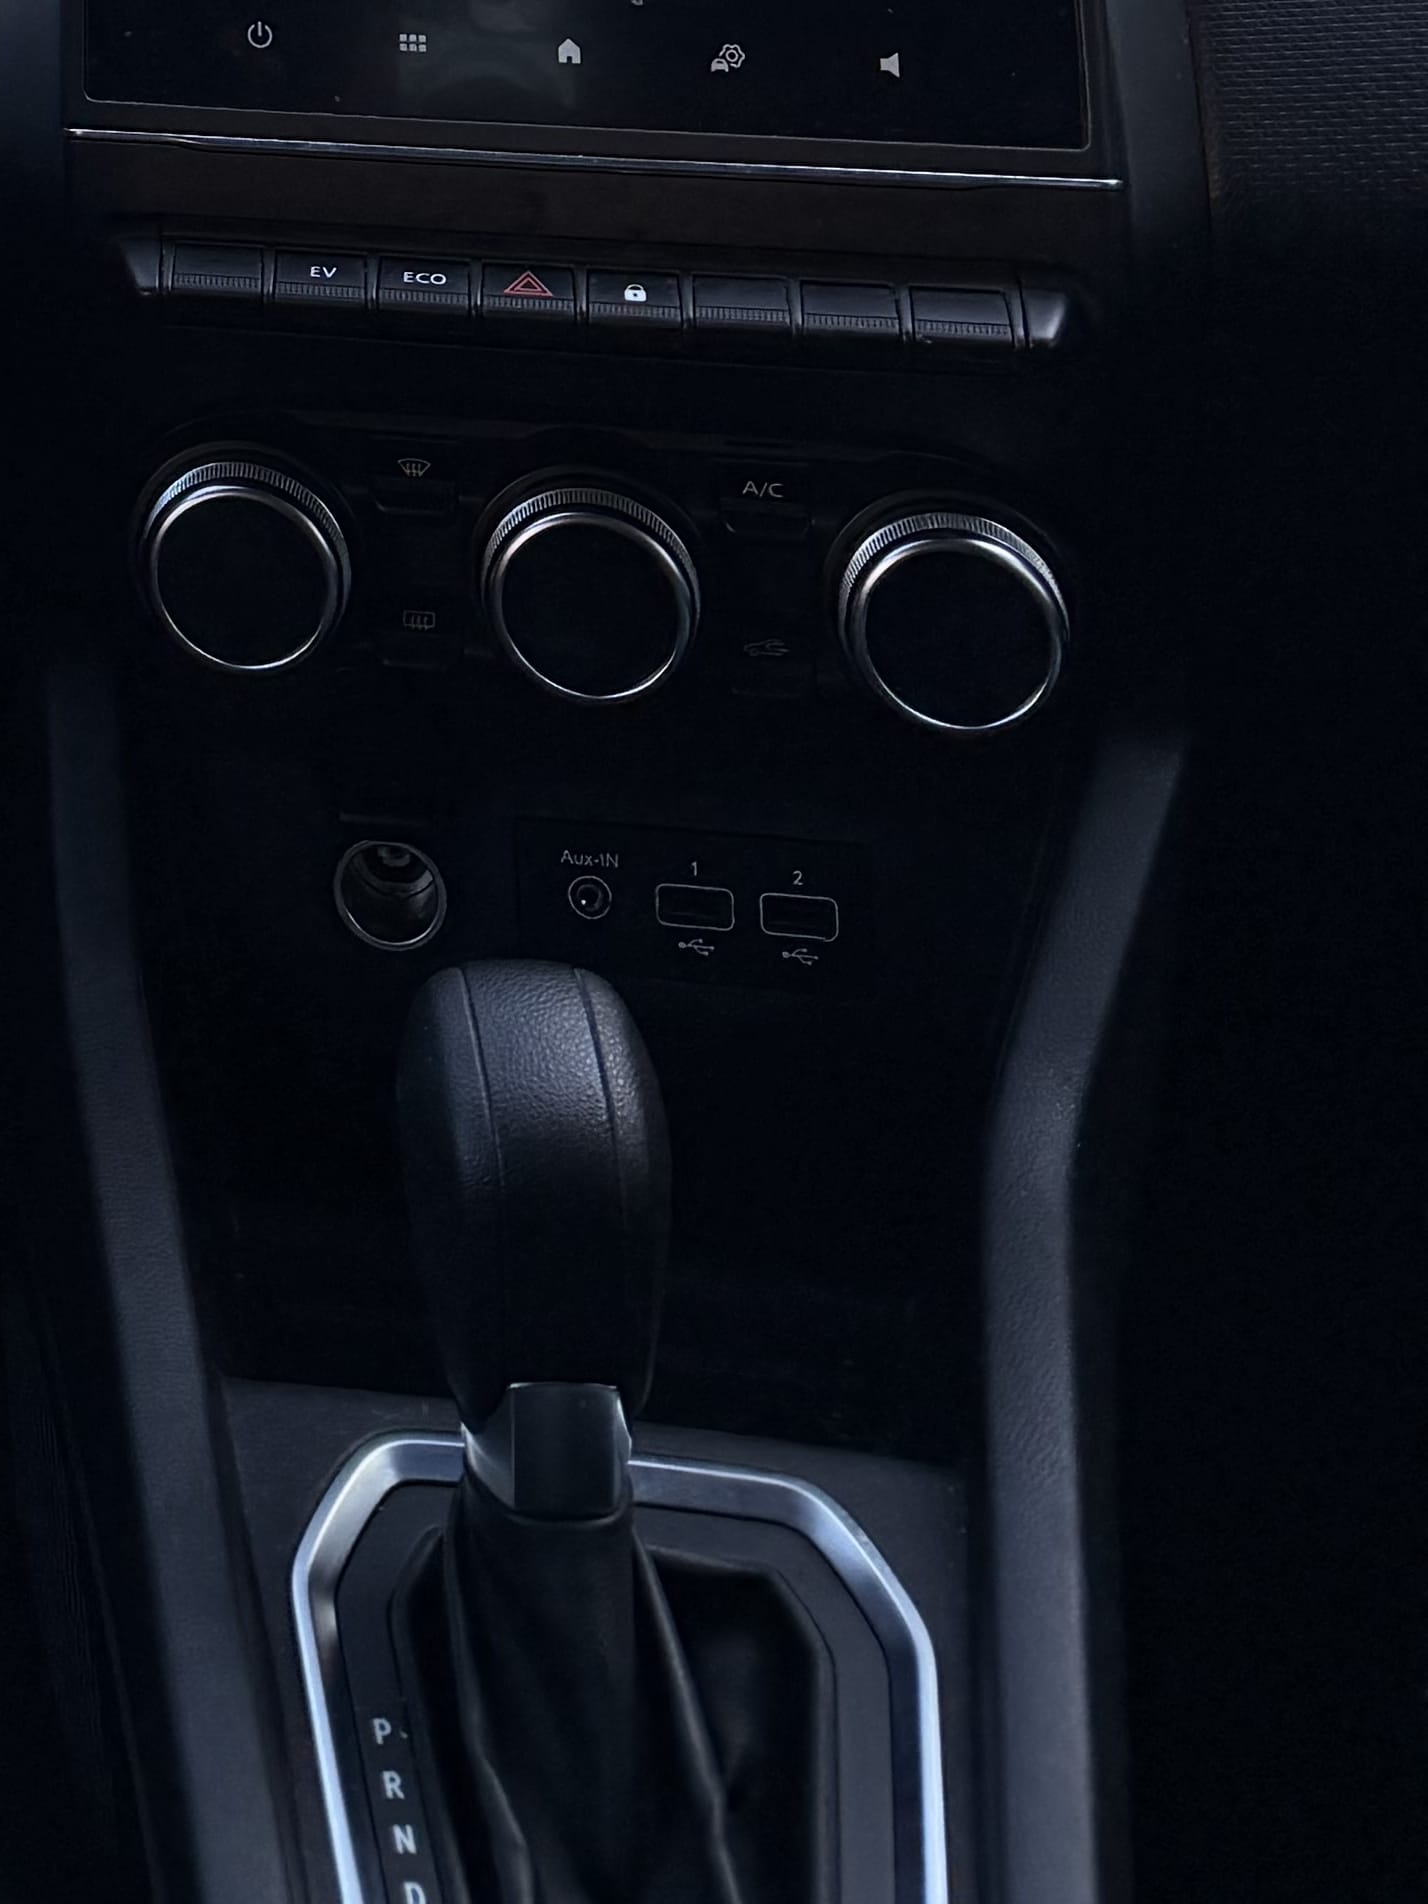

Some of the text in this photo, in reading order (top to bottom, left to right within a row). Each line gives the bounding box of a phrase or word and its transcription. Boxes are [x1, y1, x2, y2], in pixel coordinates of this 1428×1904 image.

[309, 265, 337, 279] EV
[402, 271, 447, 285] ECO
[741, 480, 785, 499] A/C
[559, 849, 620, 869] Aux-IN
[690, 860, 699, 877] 1
[791, 869, 804, 886] 2
[372, 1717, 392, 1745] P
[382, 1770, 406, 1800] R
[392, 1823, 417, 1855] N
[402, 1880, 427, 1904] D
